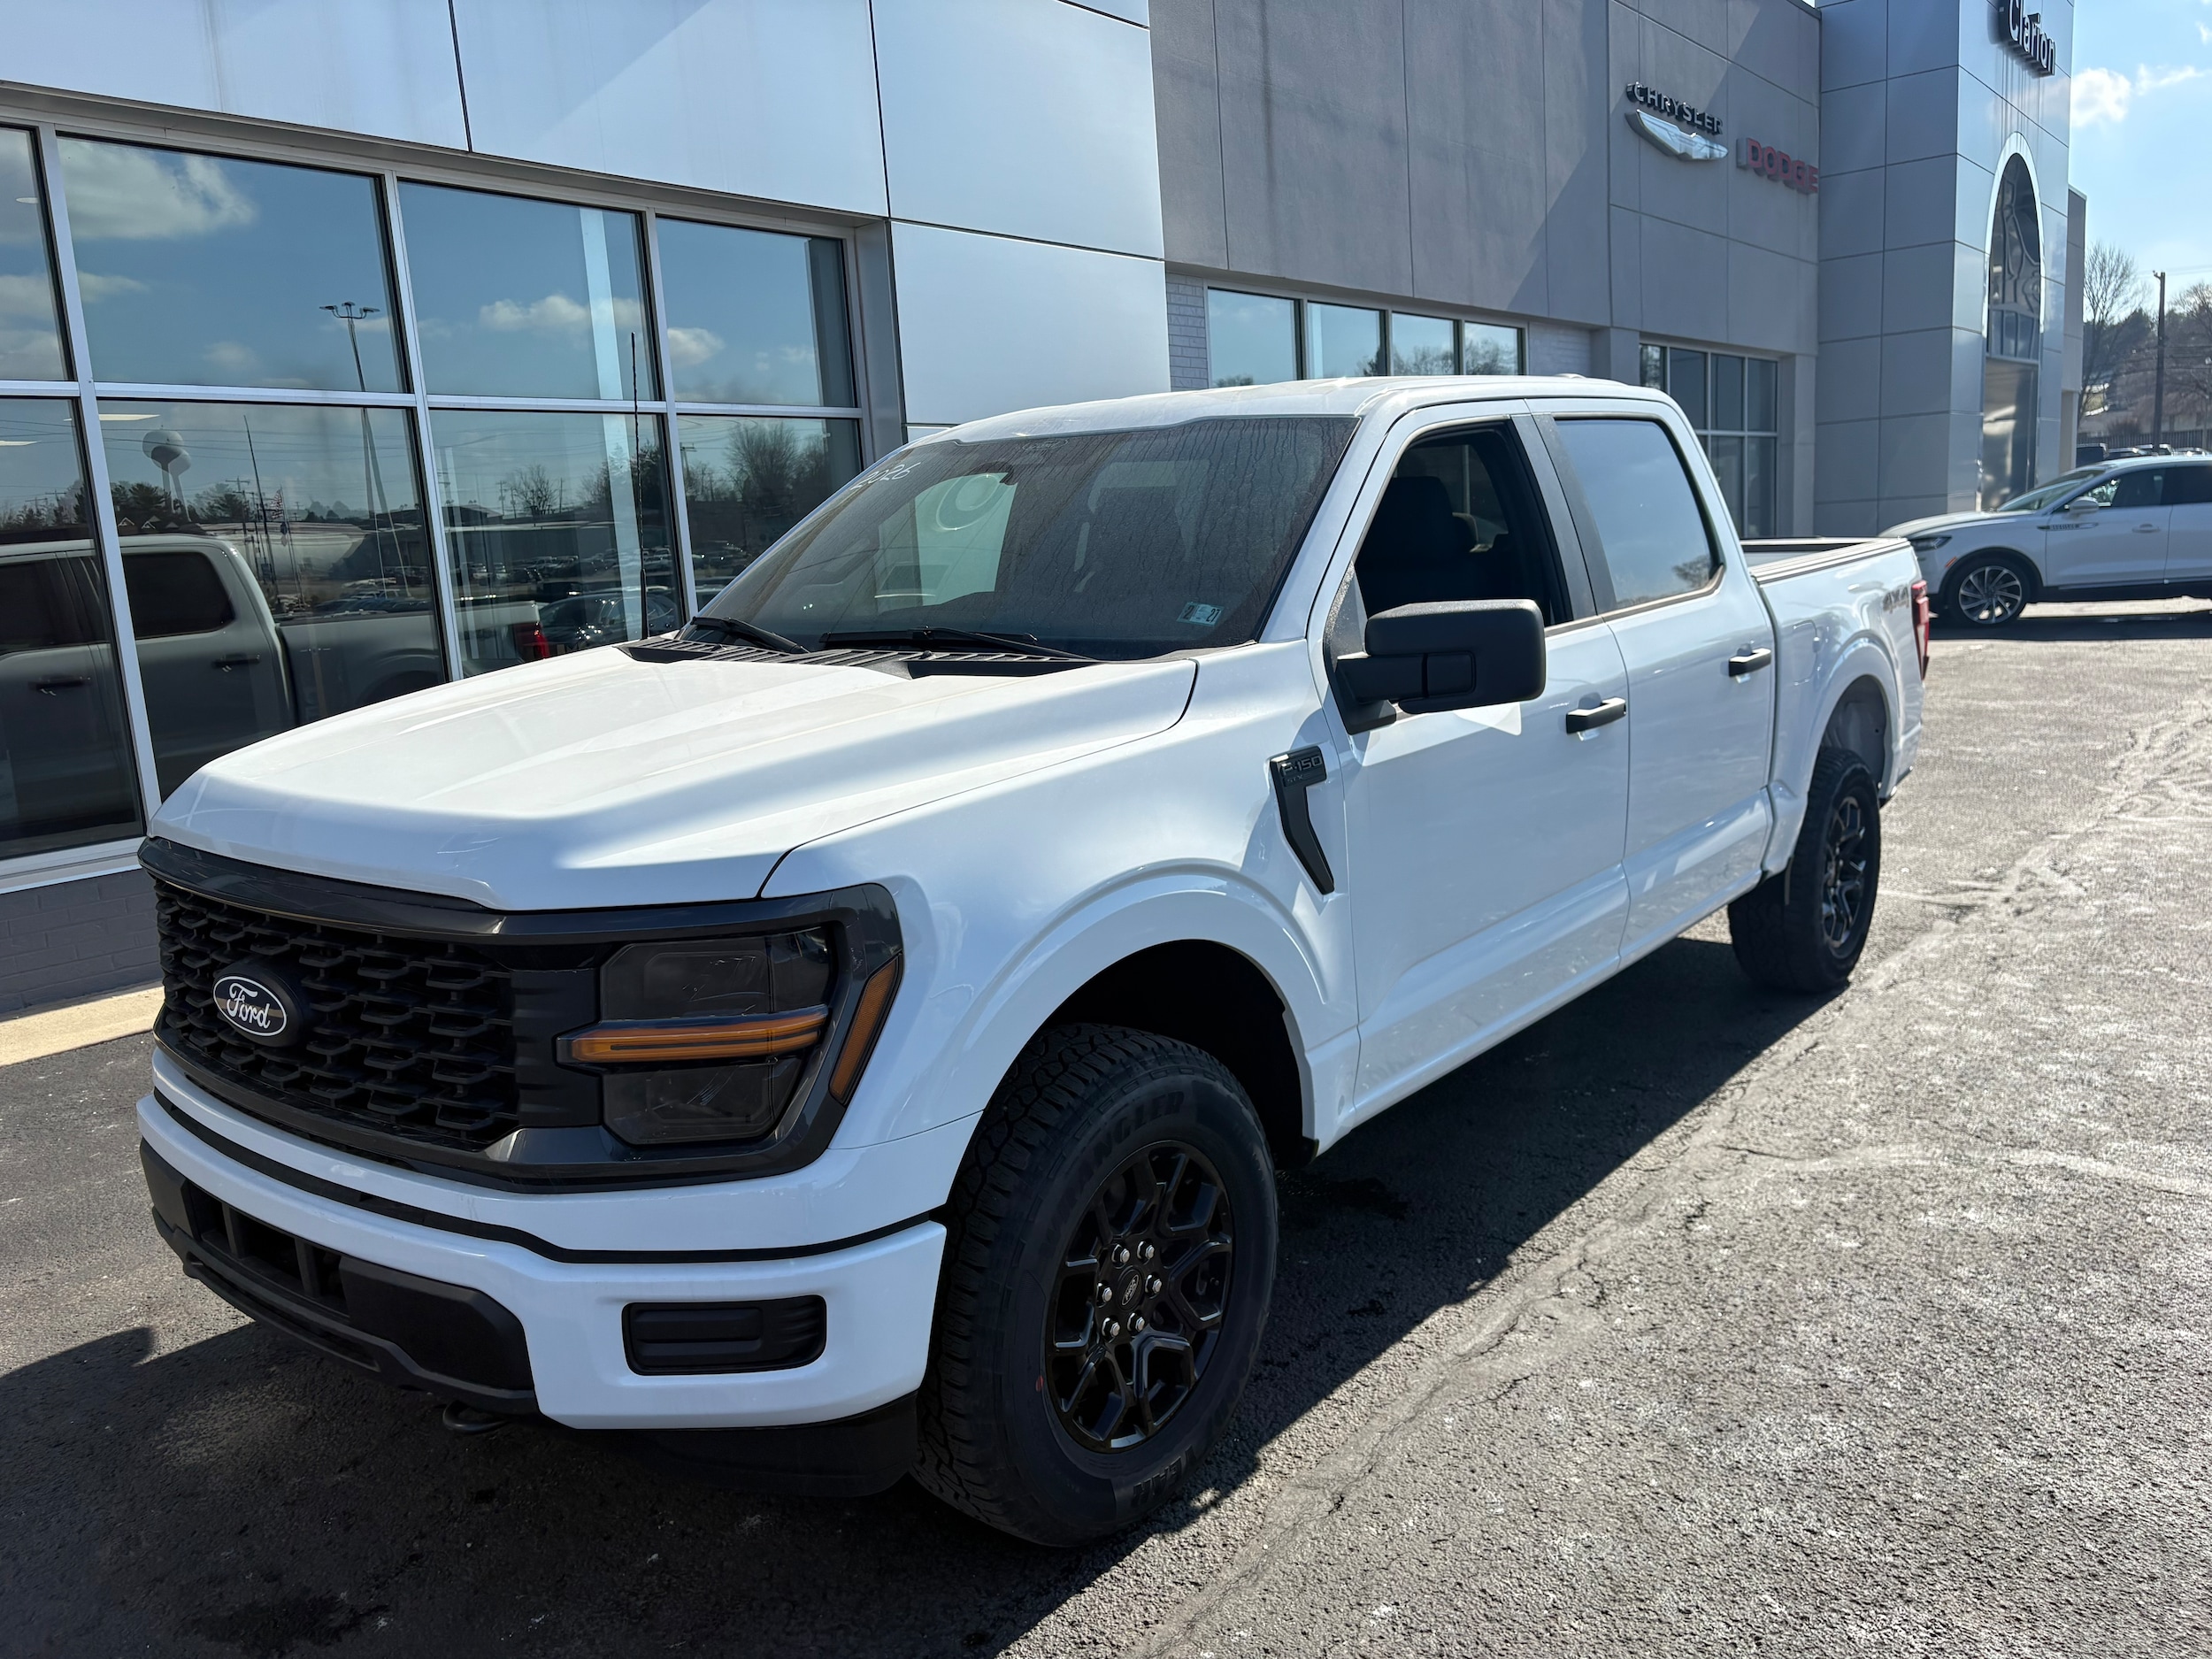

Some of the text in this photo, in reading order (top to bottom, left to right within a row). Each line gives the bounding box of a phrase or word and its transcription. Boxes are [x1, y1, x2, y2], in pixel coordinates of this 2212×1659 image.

[2008, 0, 2055, 75] Clarion
[1629, 82, 1724, 134] CHRYSLER
[1746, 137, 1818, 194] DODGE
[1206, 608, 1221, 623] 27
[227, 983, 270, 1028] Ford
